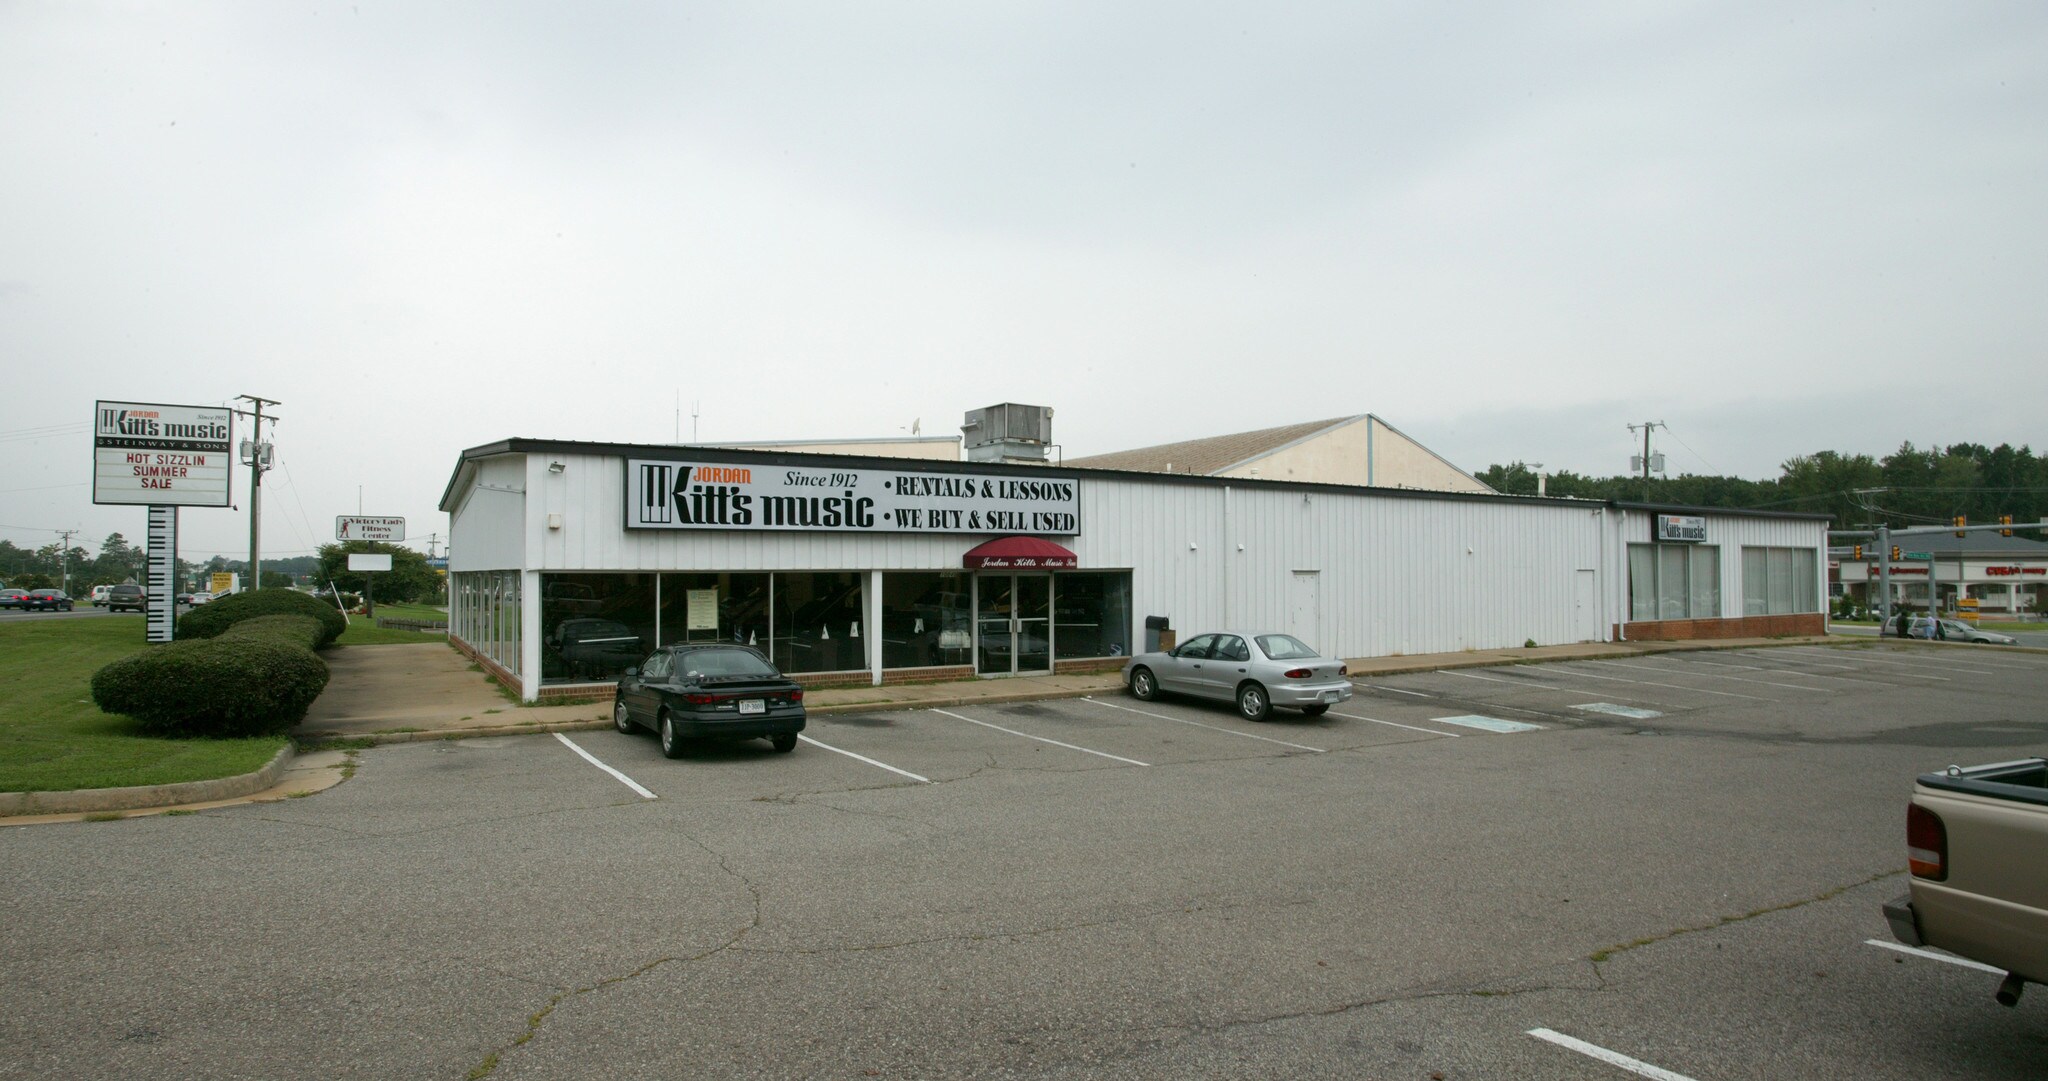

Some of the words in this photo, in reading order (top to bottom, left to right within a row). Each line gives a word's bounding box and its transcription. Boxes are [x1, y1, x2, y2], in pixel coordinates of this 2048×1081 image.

[128, 410, 159, 419] JORDAN
[117, 410, 159, 436] Kitt's
[163, 422, 227, 439] music
[107, 440, 176, 448] STEINWAY
[127, 453, 150, 464] HOT
[157, 454, 205, 466] SIZZLIN
[133, 466, 187, 477] SUMMER
[693, 466, 752, 484] JORDAN
[141, 478, 172, 489] SALE
[784, 471, 826, 487] Since
[829, 473, 858, 488] 1912
[895, 476, 975, 498] RENTALS
[981, 479, 994, 498] &
[999, 480, 1072, 501] LESSONS
[672, 466, 752, 525] Kitt's
[760, 490, 875, 528] music
[895, 508, 922, 529] WE
[928, 509, 963, 529] BUY
[968, 510, 982, 530] &
[986, 510, 1027, 531] SELL
[1032, 512, 1075, 531] USED
[1682, 525, 1704, 539] music
[981, 557, 1009, 568] Jordan
[1041, 558, 1063, 567] Music
